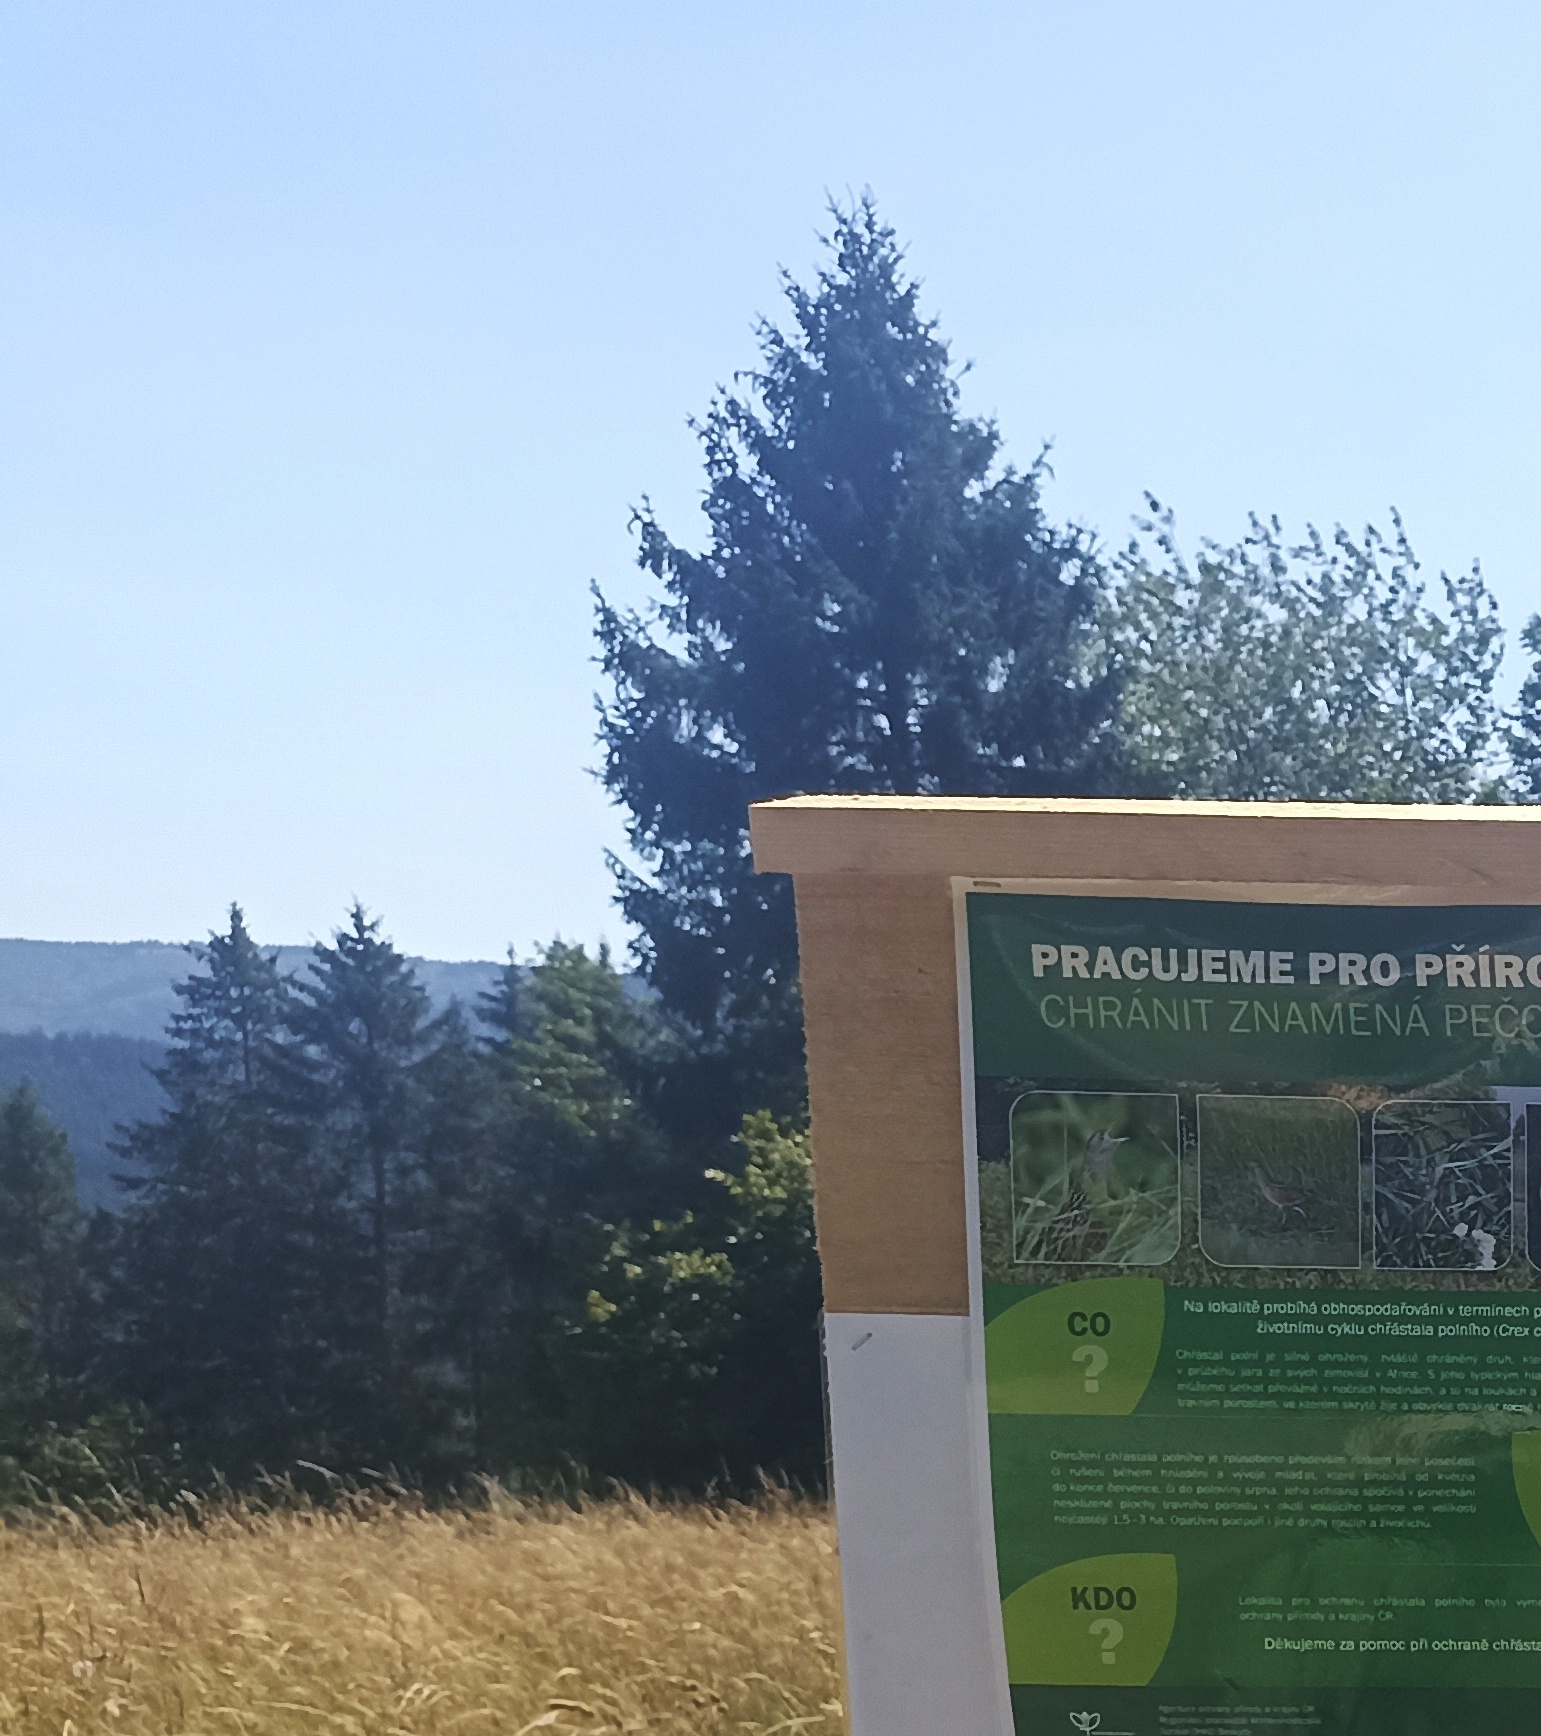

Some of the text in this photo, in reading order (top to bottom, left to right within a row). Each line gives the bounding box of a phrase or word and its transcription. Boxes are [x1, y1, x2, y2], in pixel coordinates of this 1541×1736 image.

[1031, 944, 1294, 984] PRACUJEME
[1308, 950, 1400, 986] PRO
[1039, 989, 1213, 1031] CHRÁNIT
[1228, 990, 1429, 1035] ZNAMENÁ
[1183, 1298, 1203, 1313] Na
[1207, 1298, 1260, 1314] lokalitě
[1263, 1299, 1317, 1317] probíhá
[1320, 1300, 1443, 1319] obhospodařování
[1446, 1305, 1454, 1316] v
[1458, 1302, 1529, 1317] termínech
[1067, 1311, 1112, 1337] CO
[1256, 1319, 1323, 1334] životnímu
[1327, 1320, 1364, 1338] cyklu
[1367, 1321, 1433, 1336] chřástala
[1437, 1321, 1490, 1339] polního
[1493, 1322, 1529, 1340] (Crex
[1072, 1345, 1109, 1393] ?
[1070, 1586, 1137, 1611] KDO
[1088, 1618, 1124, 1665] ?
[1264, 1636, 1335, 1653] Děkujeme
[1339, 1640, 1354, 1651] za
[1359, 1640, 1405, 1653] pomoc
[1409, 1637, 1428, 1653] při
[1431, 1637, 1489, 1651] ochraně
